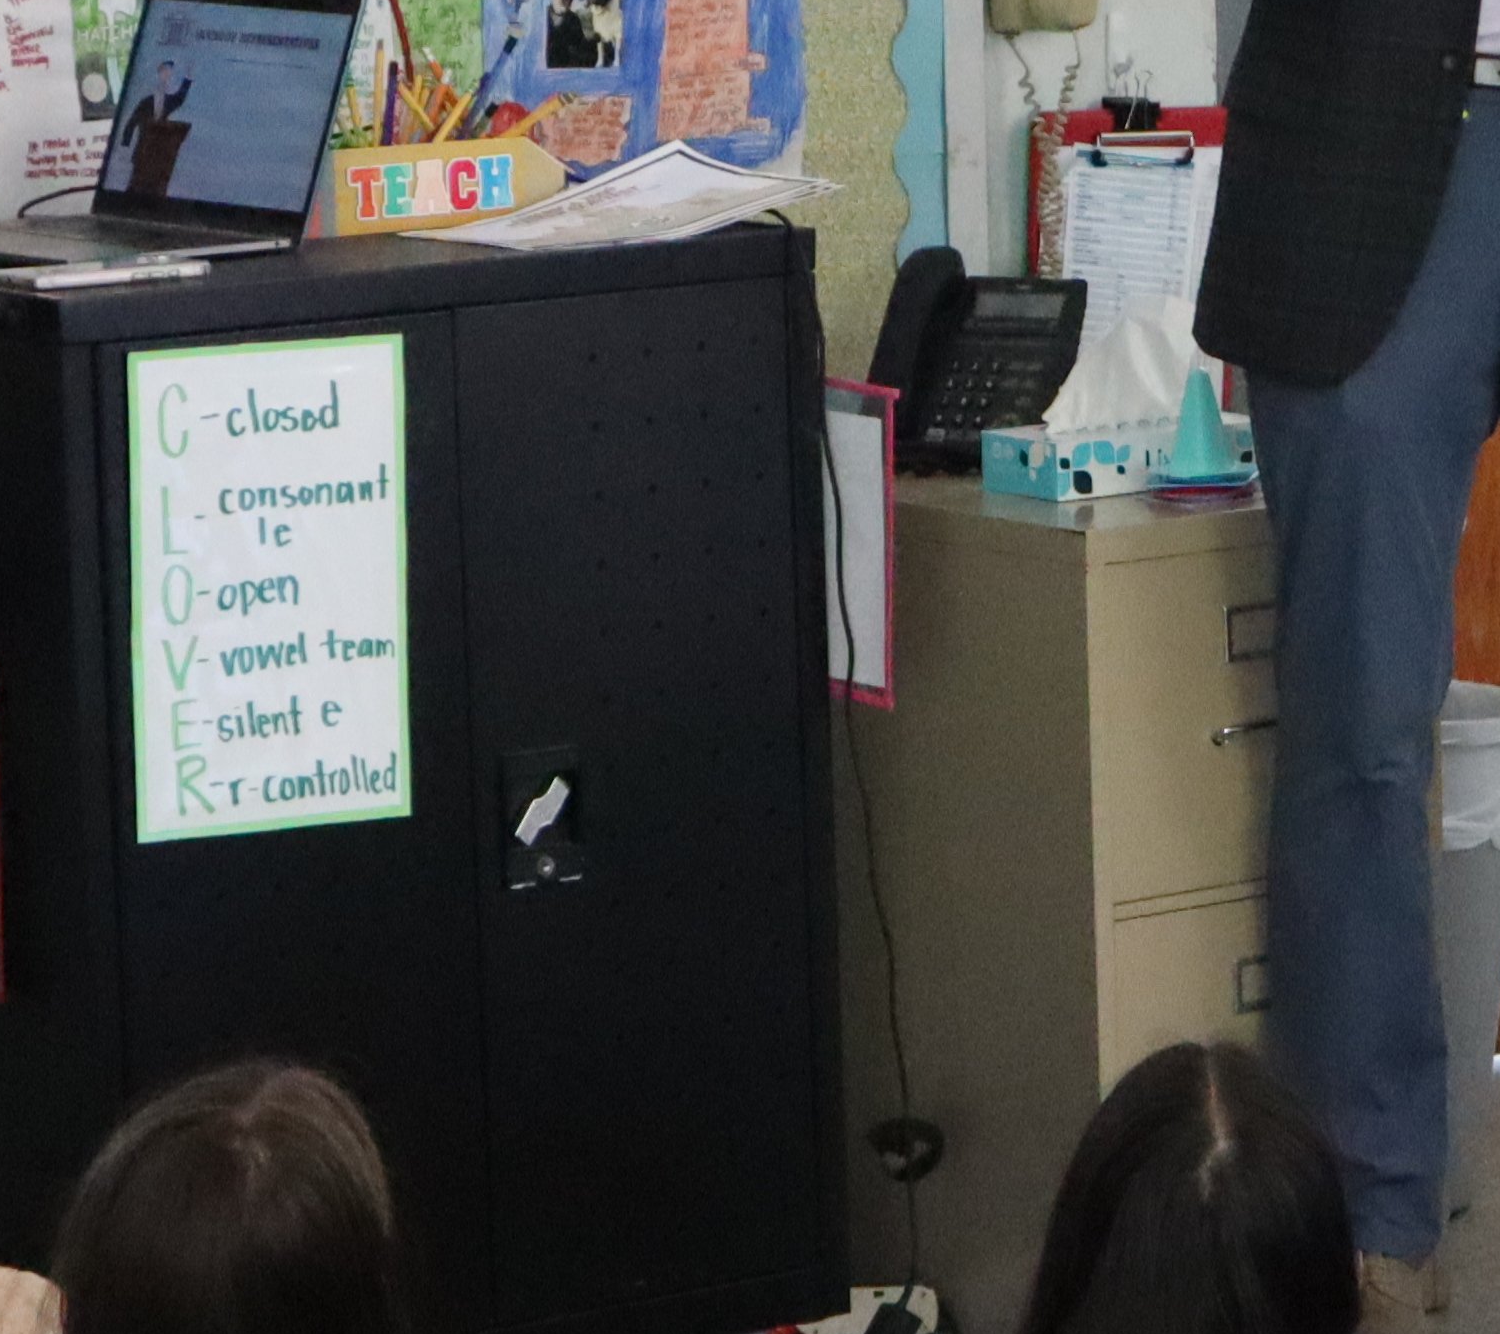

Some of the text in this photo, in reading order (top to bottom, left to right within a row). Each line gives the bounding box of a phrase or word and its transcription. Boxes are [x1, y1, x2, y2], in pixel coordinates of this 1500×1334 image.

[348, 152, 515, 221] TEACH
[218, 465, 390, 516] consonant
[258, 514, 292, 549] le
[219, 632, 309, 678] vowel
[320, 630, 396, 667] team
[321, 694, 343, 728] e
